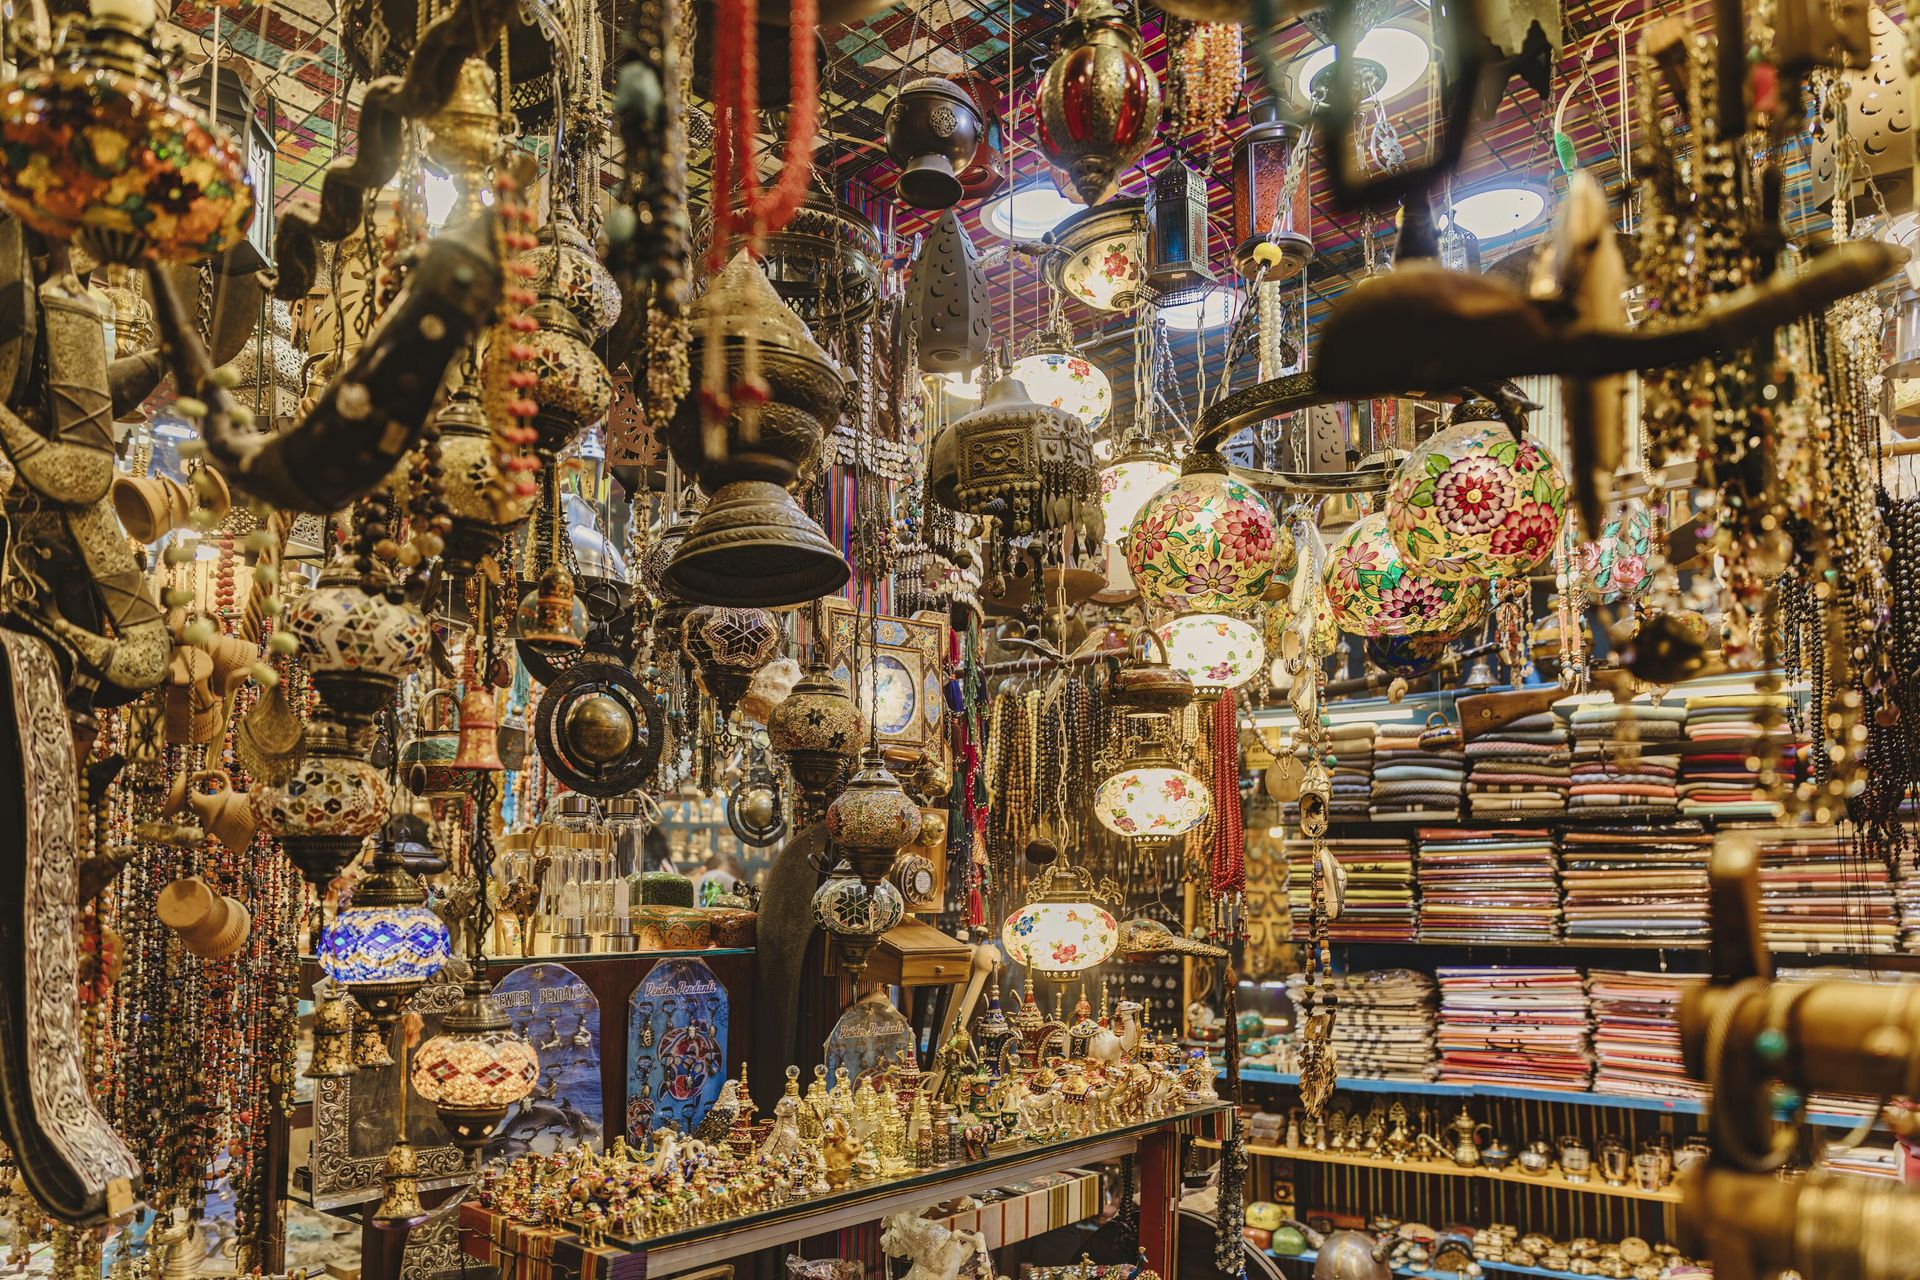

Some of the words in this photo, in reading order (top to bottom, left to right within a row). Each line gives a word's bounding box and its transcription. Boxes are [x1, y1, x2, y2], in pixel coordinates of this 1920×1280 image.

[645, 982, 676, 996] Pewter
[676, 980, 716, 995] Pendants
[868, 1020, 904, 1036] Pendants
